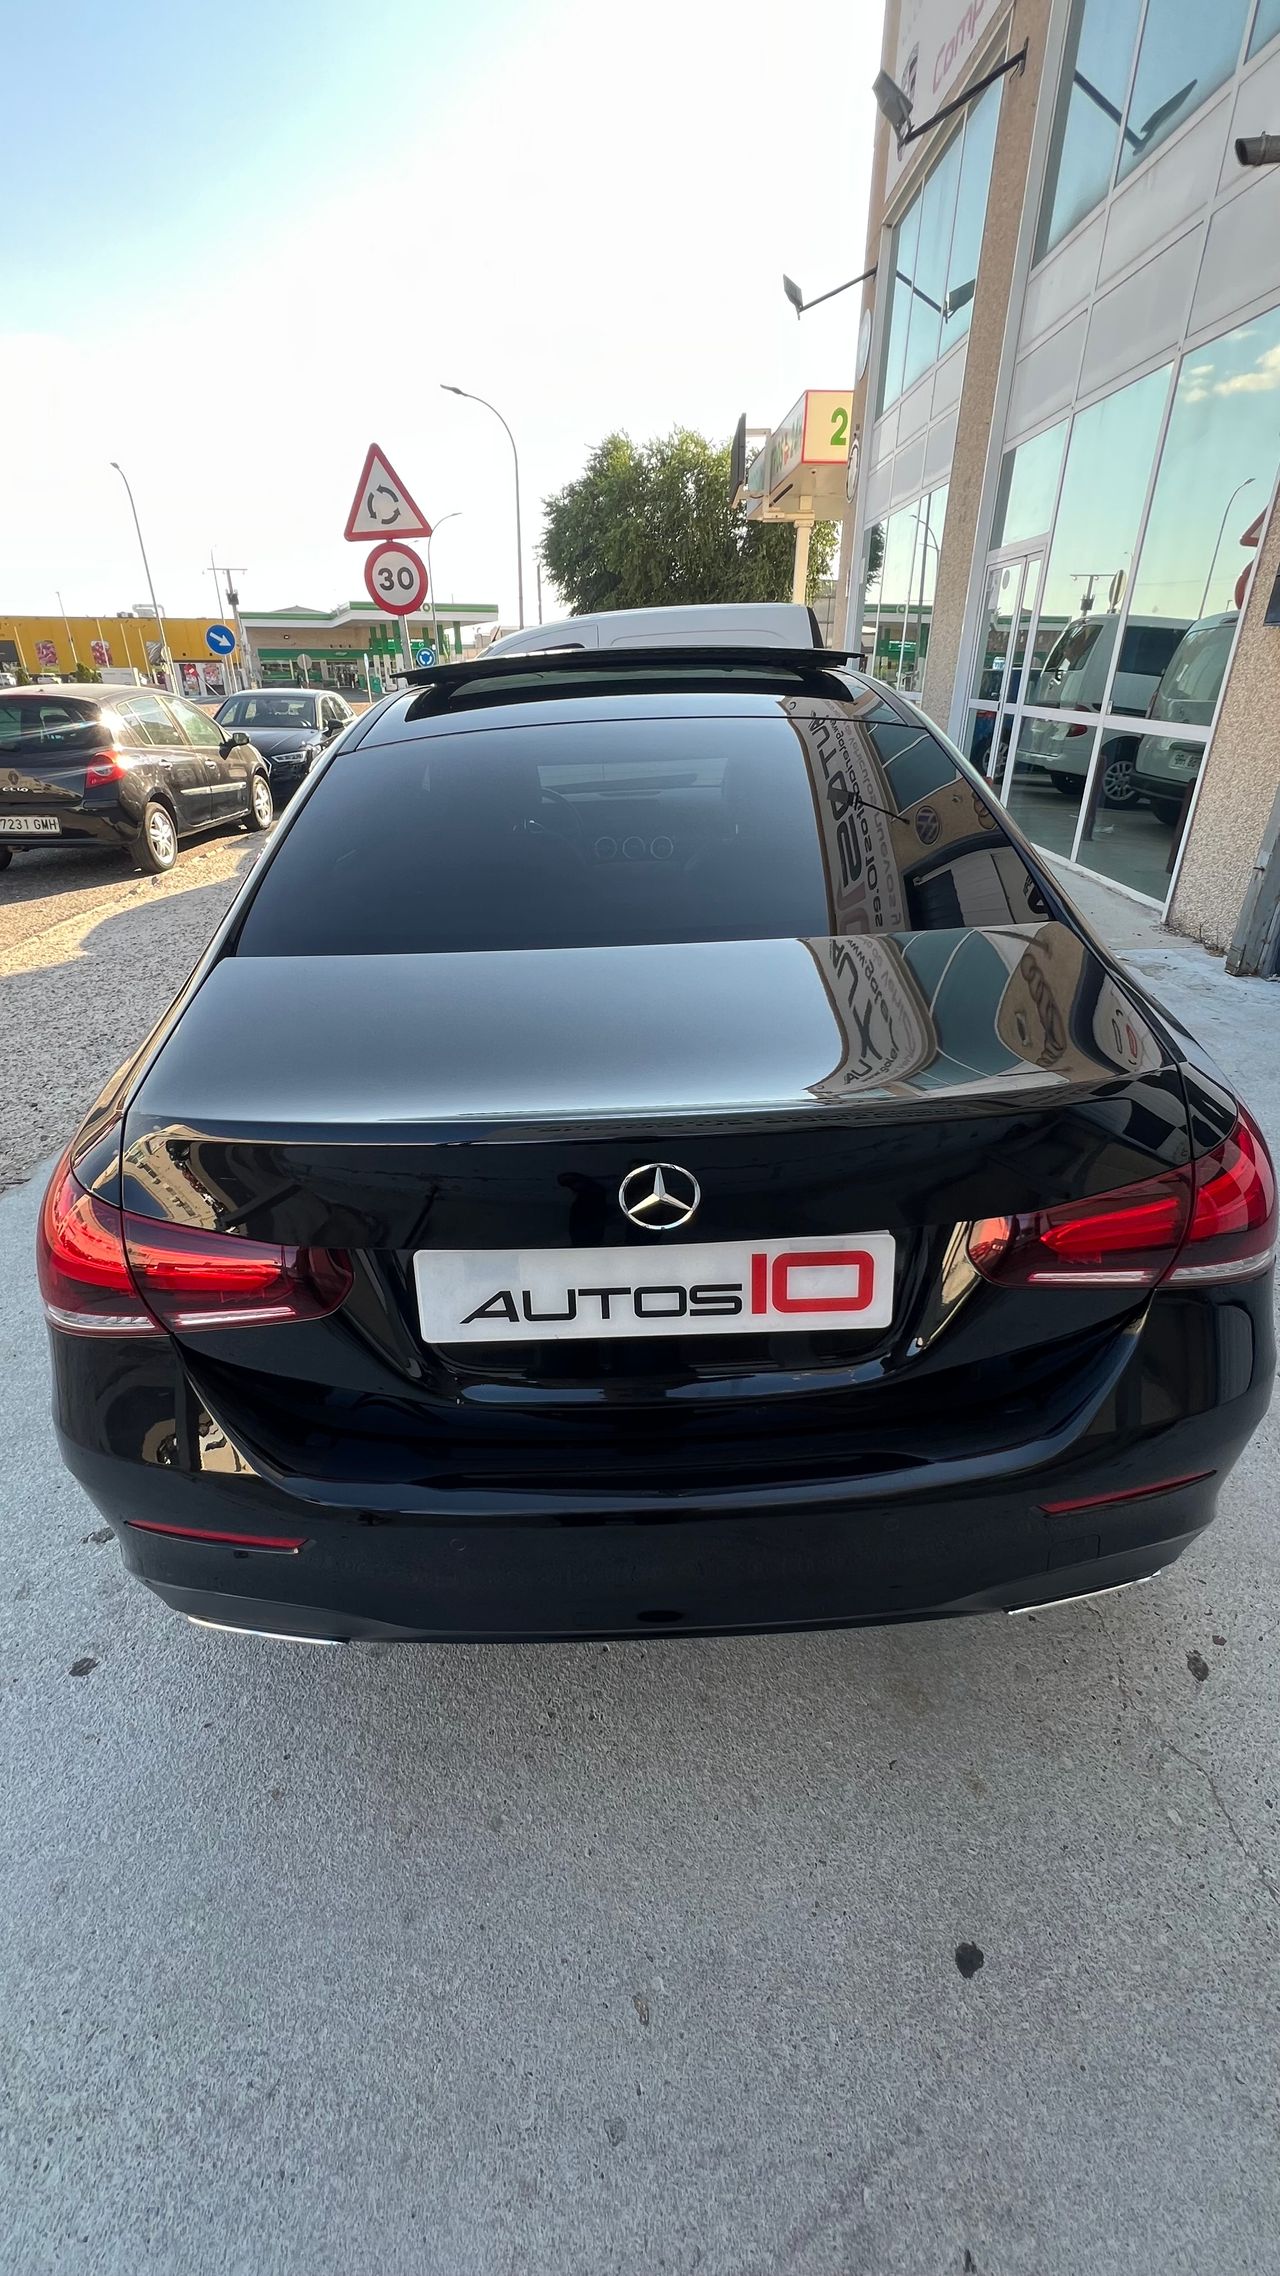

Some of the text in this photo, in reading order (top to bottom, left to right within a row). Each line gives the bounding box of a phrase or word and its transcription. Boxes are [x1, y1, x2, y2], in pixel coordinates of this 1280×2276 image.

[830, 407, 848, 446] 2
[378, 566, 414, 591] 30
[0, 818, 57, 830] 7231 GMH
[459, 1249, 875, 1325] AUTOS10
